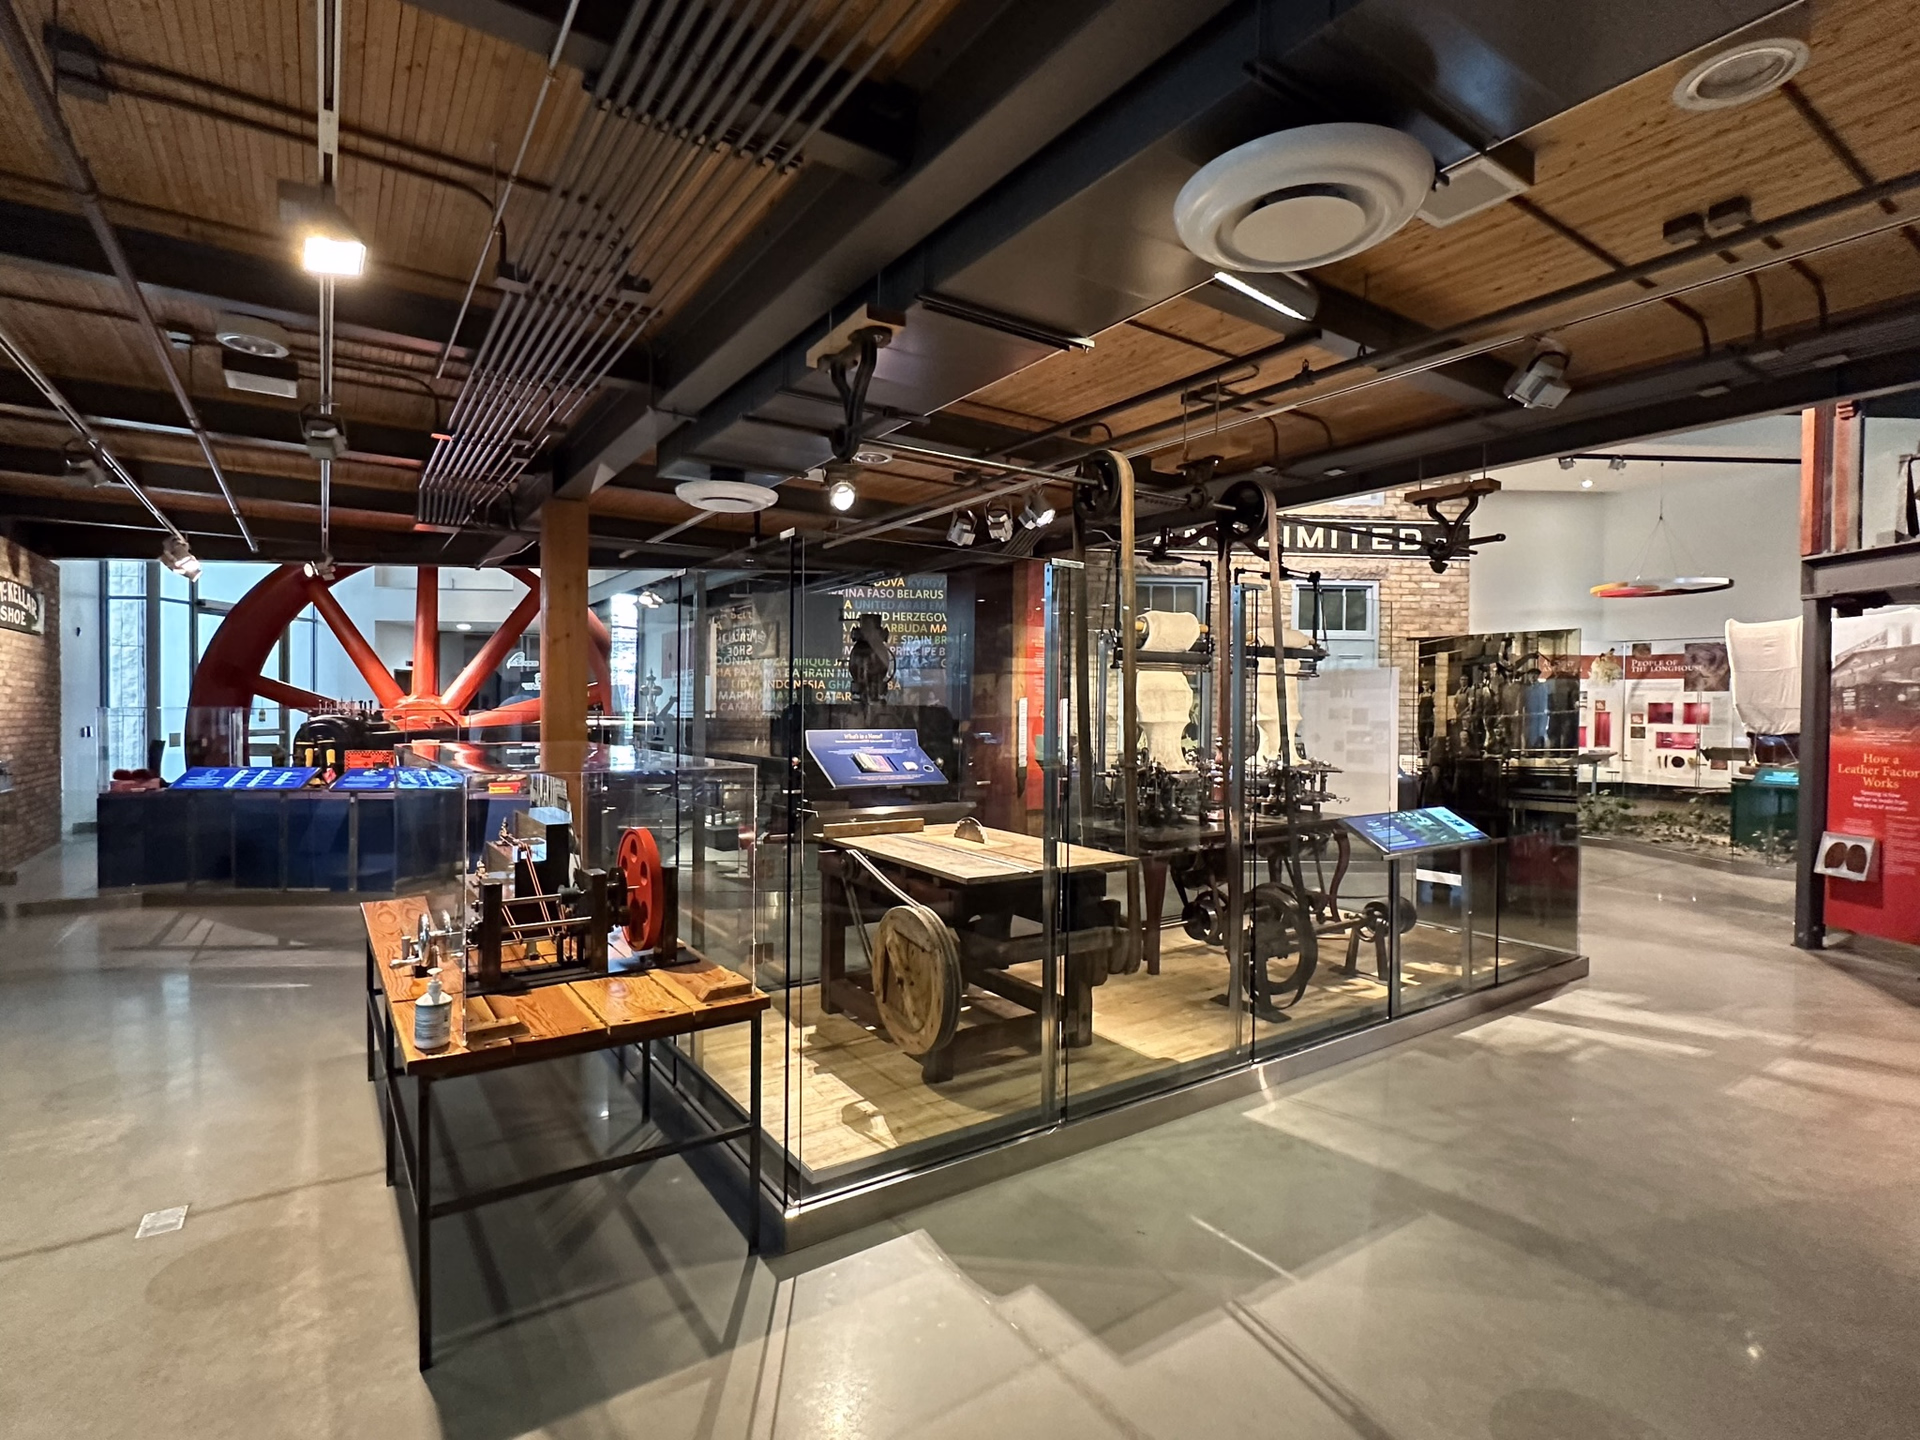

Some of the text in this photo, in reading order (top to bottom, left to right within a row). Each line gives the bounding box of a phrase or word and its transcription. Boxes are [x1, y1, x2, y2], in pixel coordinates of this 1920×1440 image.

[1257, 526, 1422, 550] LIMITED
[867, 588, 894, 598] FASO
[897, 589, 944, 599] BELARUS
[855, 600, 895, 610] UNITED
[897, 601, 927, 610] ARAB
[0, 605, 26, 626] SHOE
[901, 635, 931, 645] SPAIN
[1631, 659, 1664, 667] PEOPLE
[815, 691, 852, 702] QATAR
[1863, 753, 1899, 765] How a
[1838, 763, 1879, 775] Leather
[1863, 776, 1899, 789] Works
